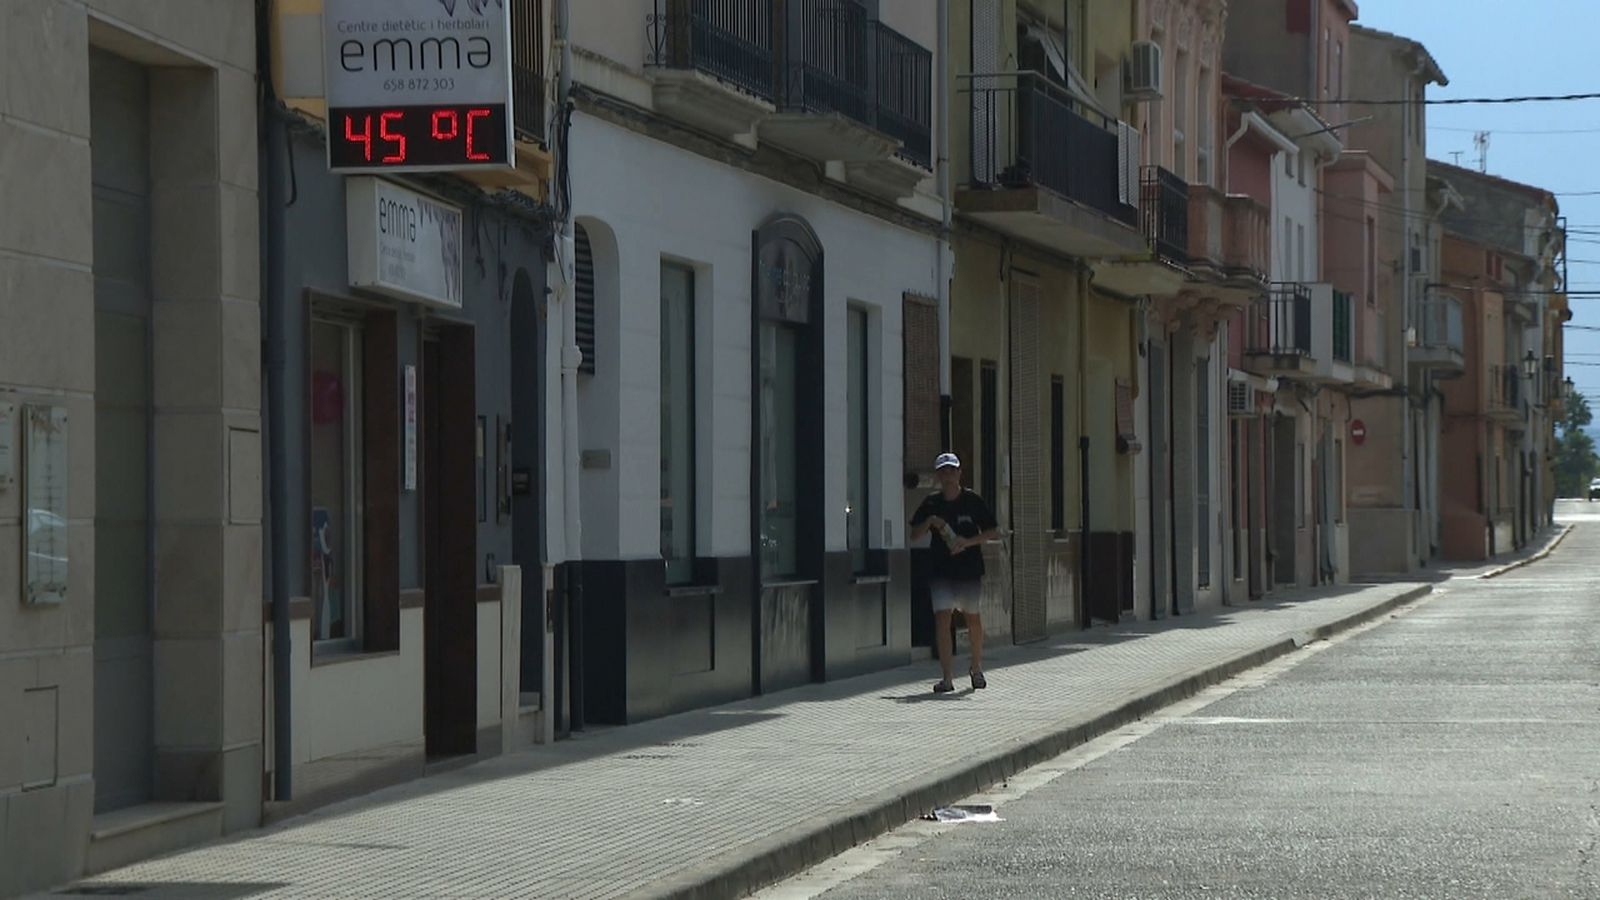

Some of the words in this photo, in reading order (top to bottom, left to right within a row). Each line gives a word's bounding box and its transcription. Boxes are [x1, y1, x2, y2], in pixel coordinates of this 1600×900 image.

[337, 20, 378, 33] Centre
[437, 17, 489, 31] herbolari
[340, 37, 491, 72] emma
[383, 79, 404, 92] 658
[408, 79, 429, 91] 872
[433, 78, 455, 91] 303
[345, 111, 406, 163] 45
[379, 196, 416, 243] emma
